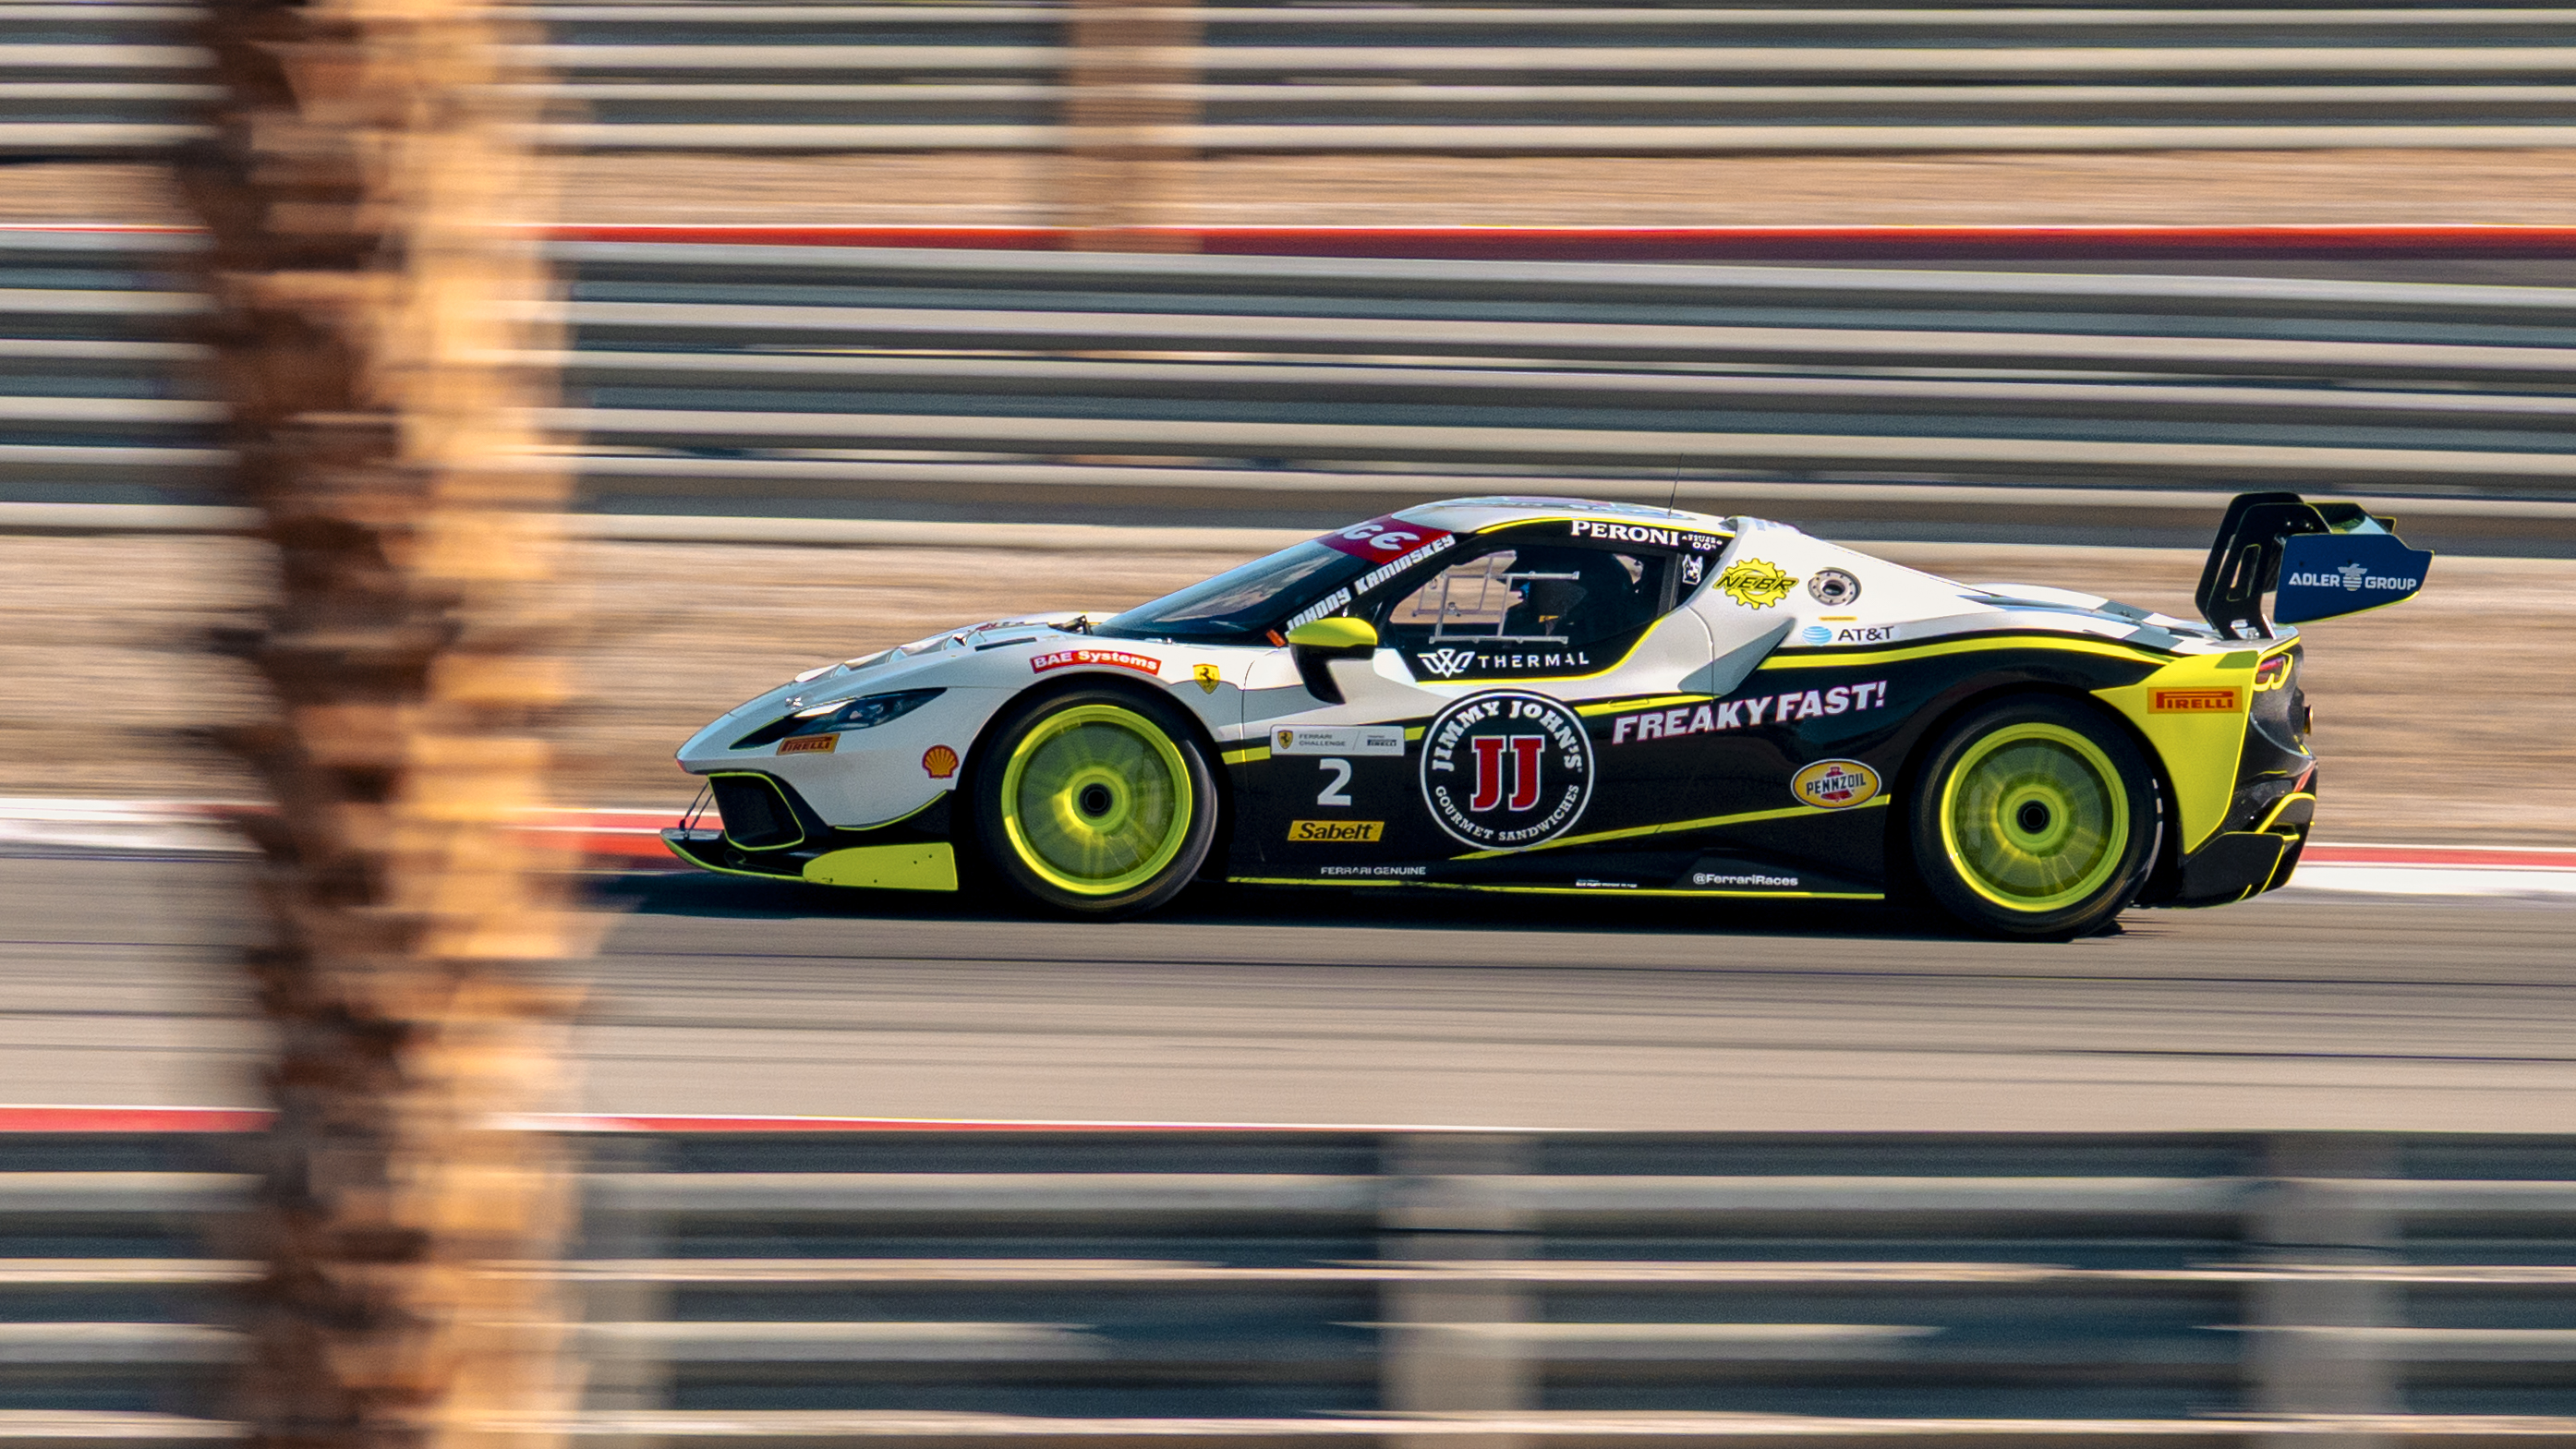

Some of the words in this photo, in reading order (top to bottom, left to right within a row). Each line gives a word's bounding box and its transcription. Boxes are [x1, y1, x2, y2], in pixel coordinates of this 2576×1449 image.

[1571, 520, 1679, 546] PERONI
[1285, 586, 1352, 639] JOHNNY
[1354, 535, 1457, 596] KAMINSKEY
[2289, 572, 2340, 587] ADLER
[2364, 575, 2417, 591] GROUP
[1838, 625, 1894, 642] AT&T
[1034, 652, 1072, 669] BAE
[1079, 650, 1157, 670] Systems
[1478, 652, 1590, 669] THERMAL
[2156, 691, 2233, 708] PIRELLI
[1612, 695, 1773, 744] FREAKY
[1775, 681, 1888, 722] FAST!
[781, 736, 833, 752] PIRELLI
[1432, 700, 1500, 772] JIMMY
[1509, 700, 1582, 772] JOHN'S
[1317, 758, 1352, 806] 2
[1470, 734, 1545, 811] JJ
[1806, 772, 1867, 796] PENNZOIL
[1435, 785, 1494, 839] GOURMET
[1498, 784, 1579, 841] SANDWICHES
[1298, 822, 1373, 840] Sabelt
[1321, 866, 1372, 875] FERRARI
[1373, 866, 1427, 875] GENUINE
[1693, 873, 1799, 887] @FerrariRaces
